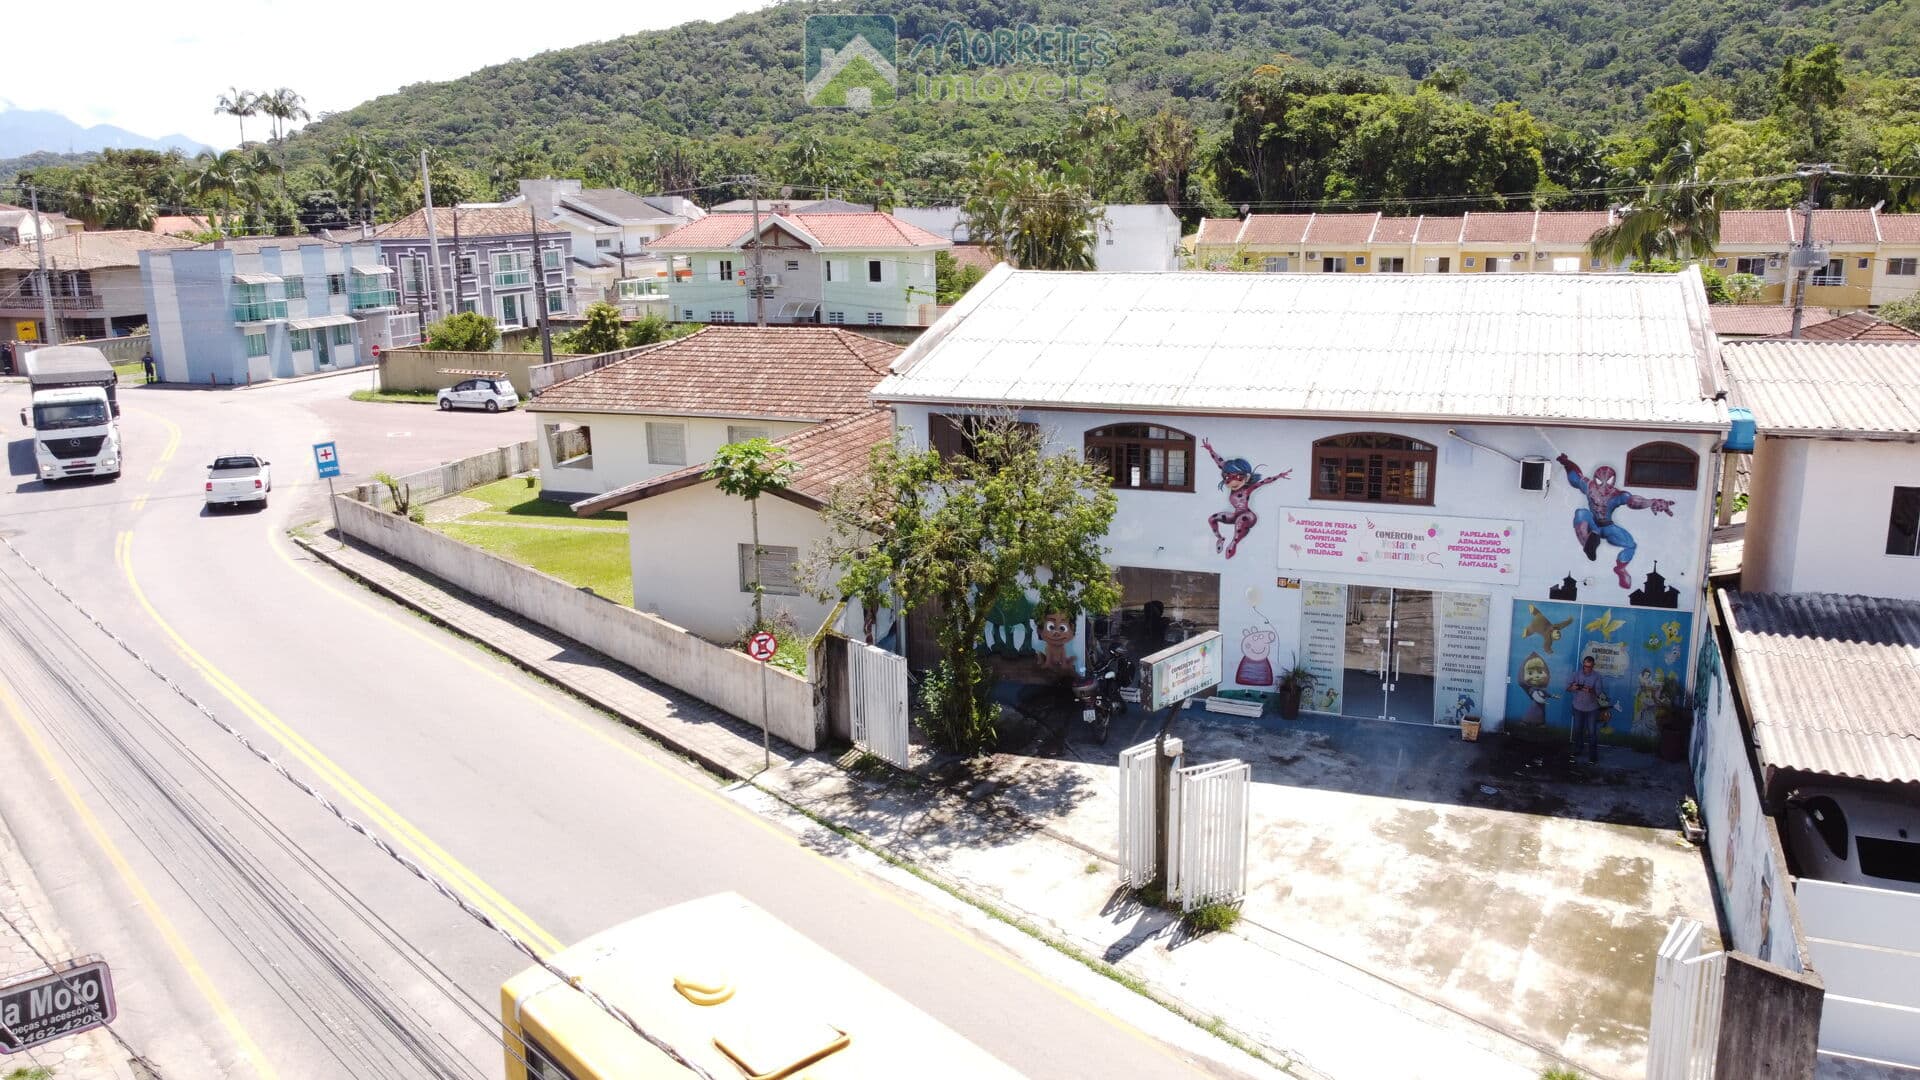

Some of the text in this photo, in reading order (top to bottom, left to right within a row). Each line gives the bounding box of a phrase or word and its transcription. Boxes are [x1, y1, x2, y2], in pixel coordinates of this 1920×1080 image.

[1296, 519, 1323, 527] ARTIGOS
[1305, 527, 1348, 535] EMBALAGENS
[1305, 534, 1347, 542] CONFEITARIA
[1307, 548, 1343, 556] UTILIDADES
[1448, 545, 1511, 554] PERSONALIZADOS
[30, 978, 99, 1020] Moto
[12, 1022, 40, 1036] peças
[42, 1019, 48, 1027] e
